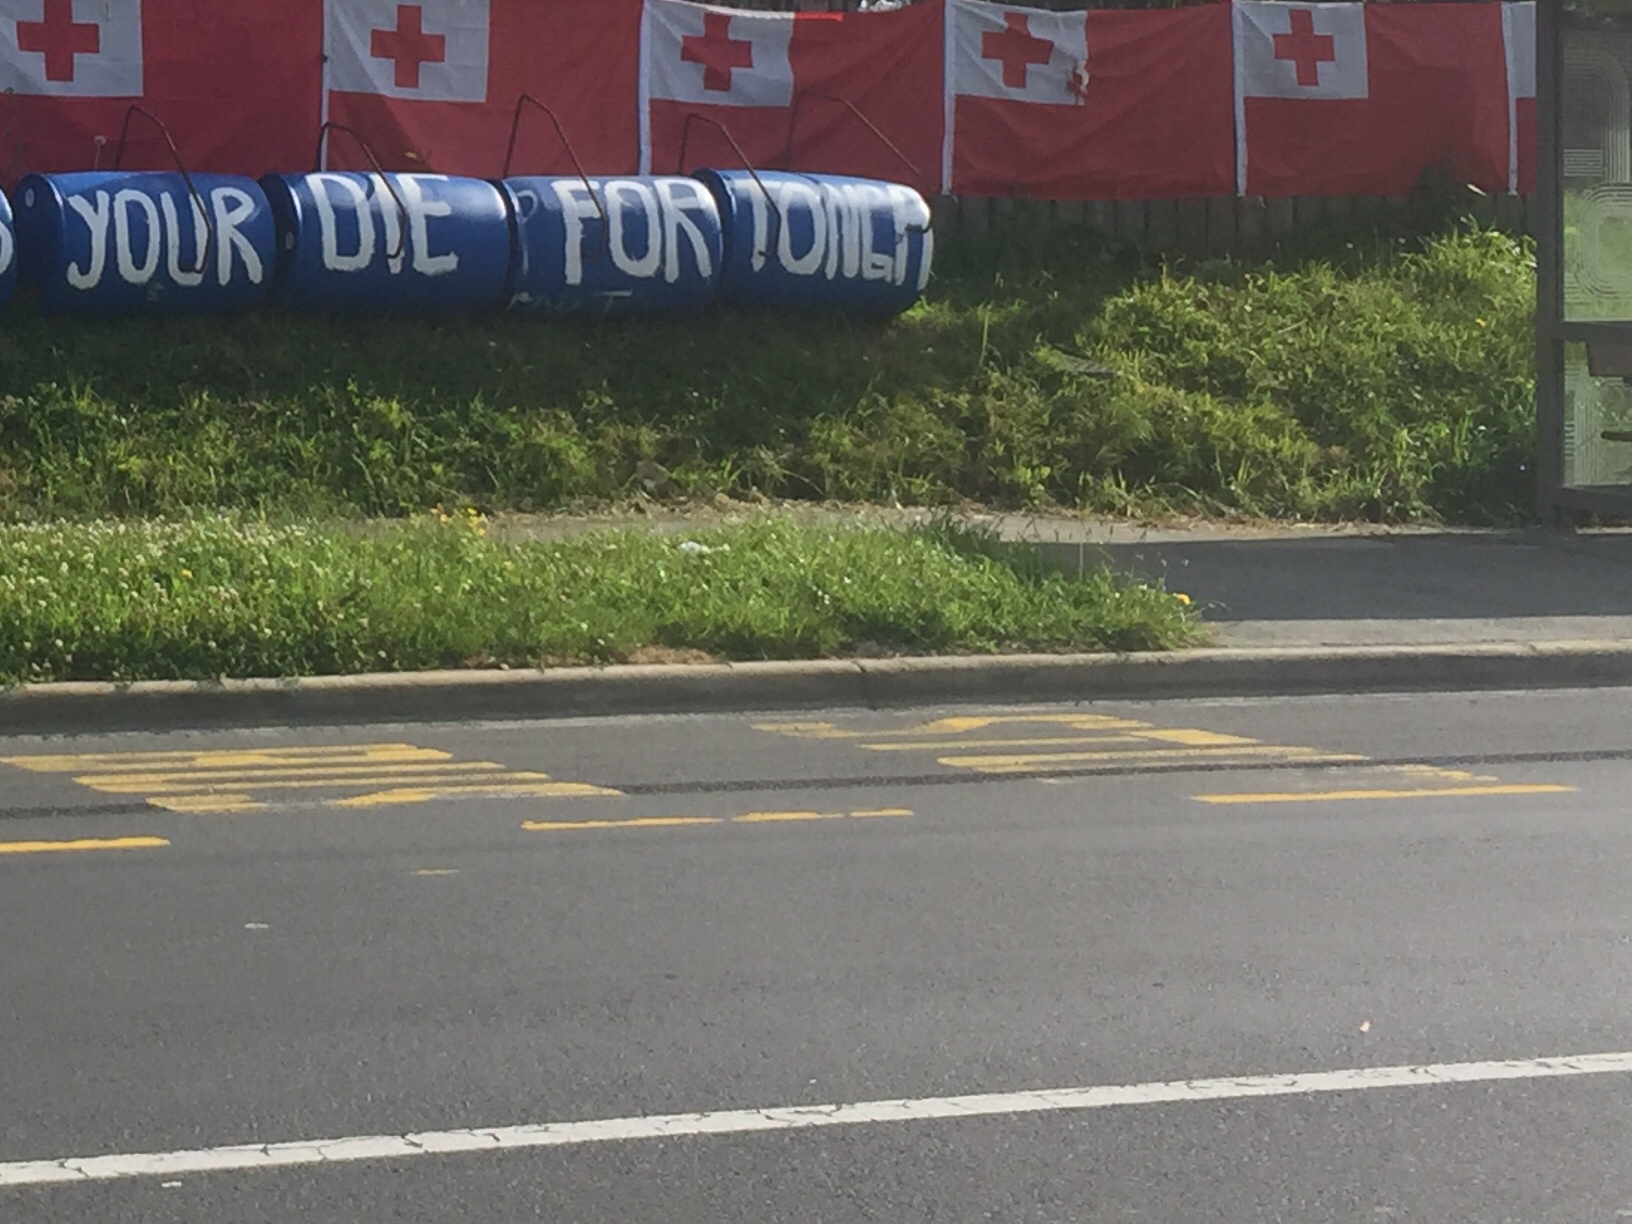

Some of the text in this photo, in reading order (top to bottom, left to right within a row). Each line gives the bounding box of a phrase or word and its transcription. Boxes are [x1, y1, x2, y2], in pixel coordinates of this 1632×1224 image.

[68, 188, 263, 290] YOUR
[306, 173, 460, 275] DIE
[552, 176, 722, 285] FOR
